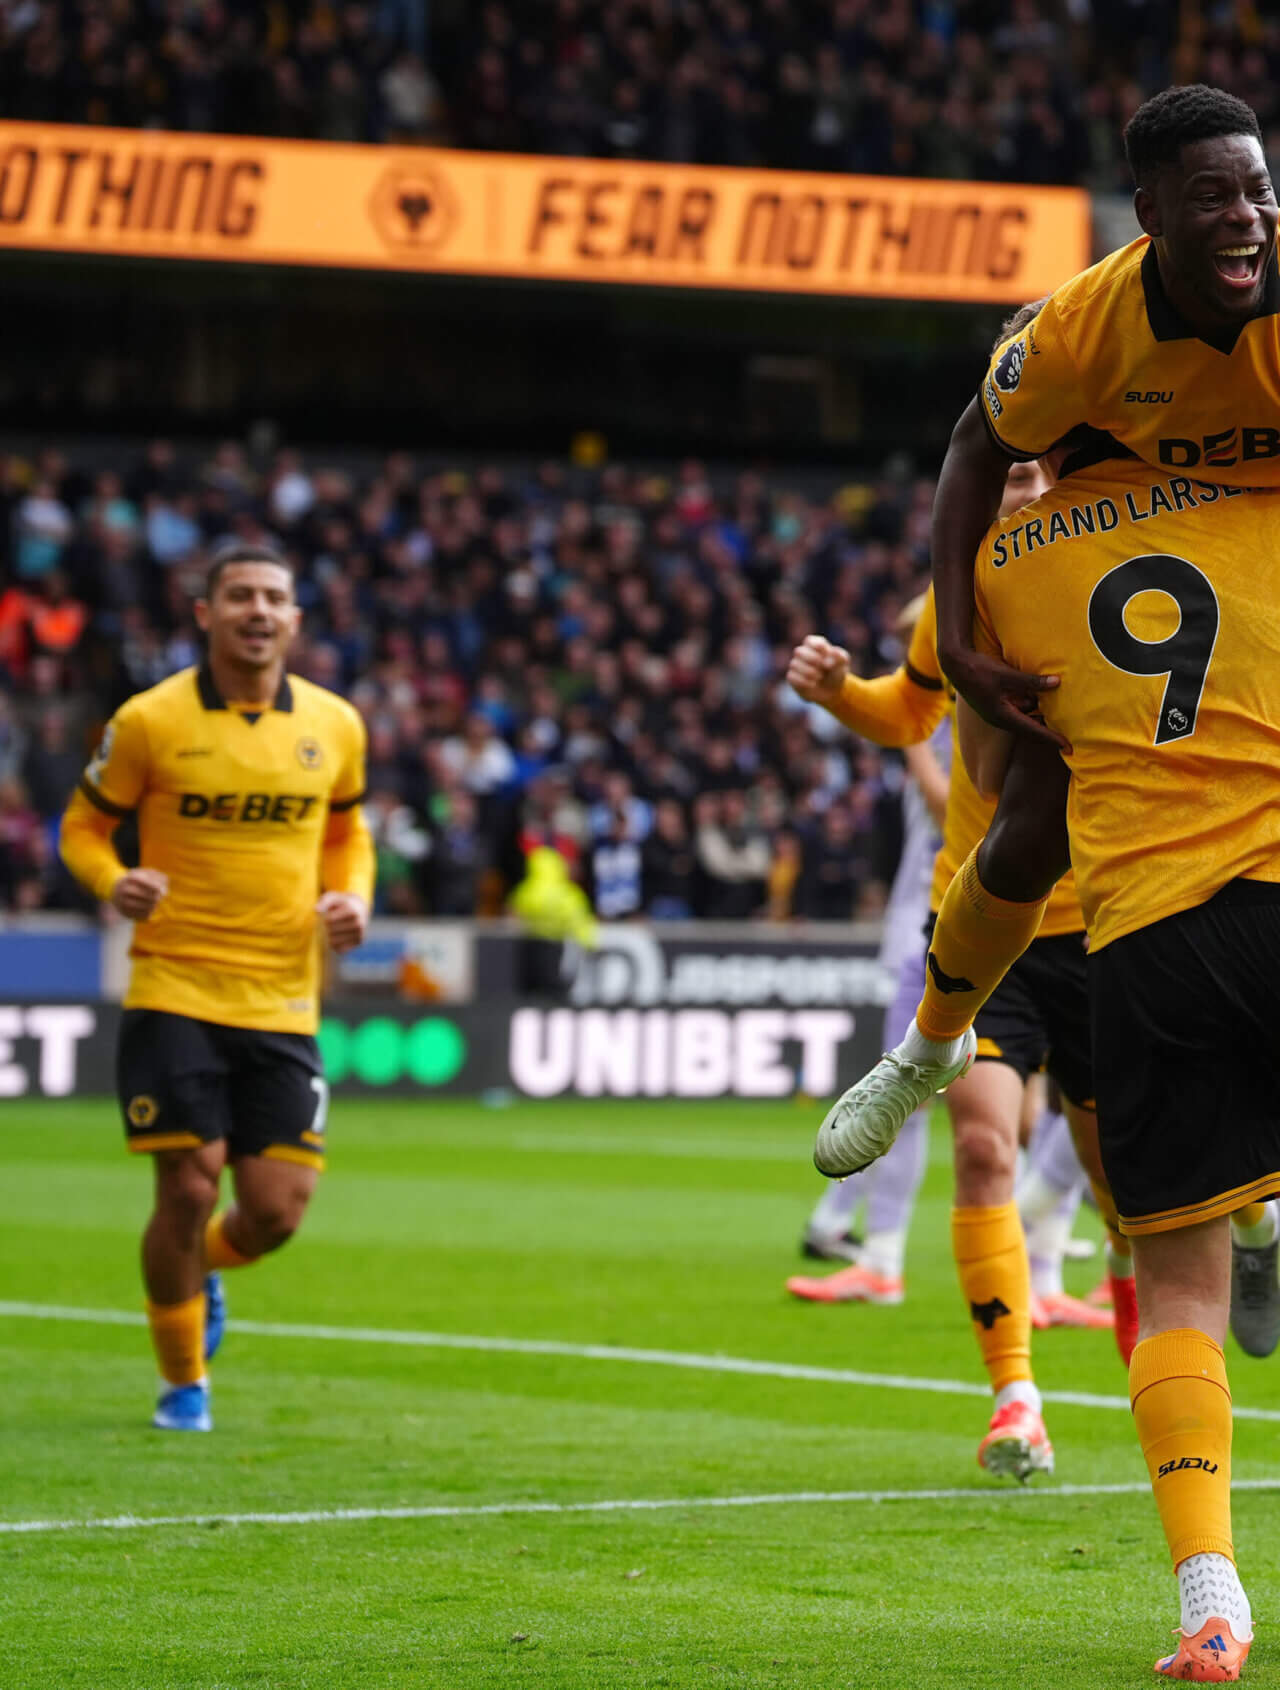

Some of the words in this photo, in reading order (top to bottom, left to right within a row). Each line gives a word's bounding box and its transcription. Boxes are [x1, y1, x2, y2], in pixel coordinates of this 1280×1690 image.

[0, 142, 266, 238] OTHING
[527, 176, 717, 264] FEAR
[733, 190, 1030, 283] NOTHING
[1124, 391, 1174, 404] SUDU
[992, 498, 1118, 568] STRAND
[1125, 476, 1262, 522] LARS
[1088, 554, 1220, 746] 9
[178, 794, 317, 822] DEBET
[508, 1008, 855, 1098] UNIBET
[1158, 1457, 1218, 1479] SUDU
